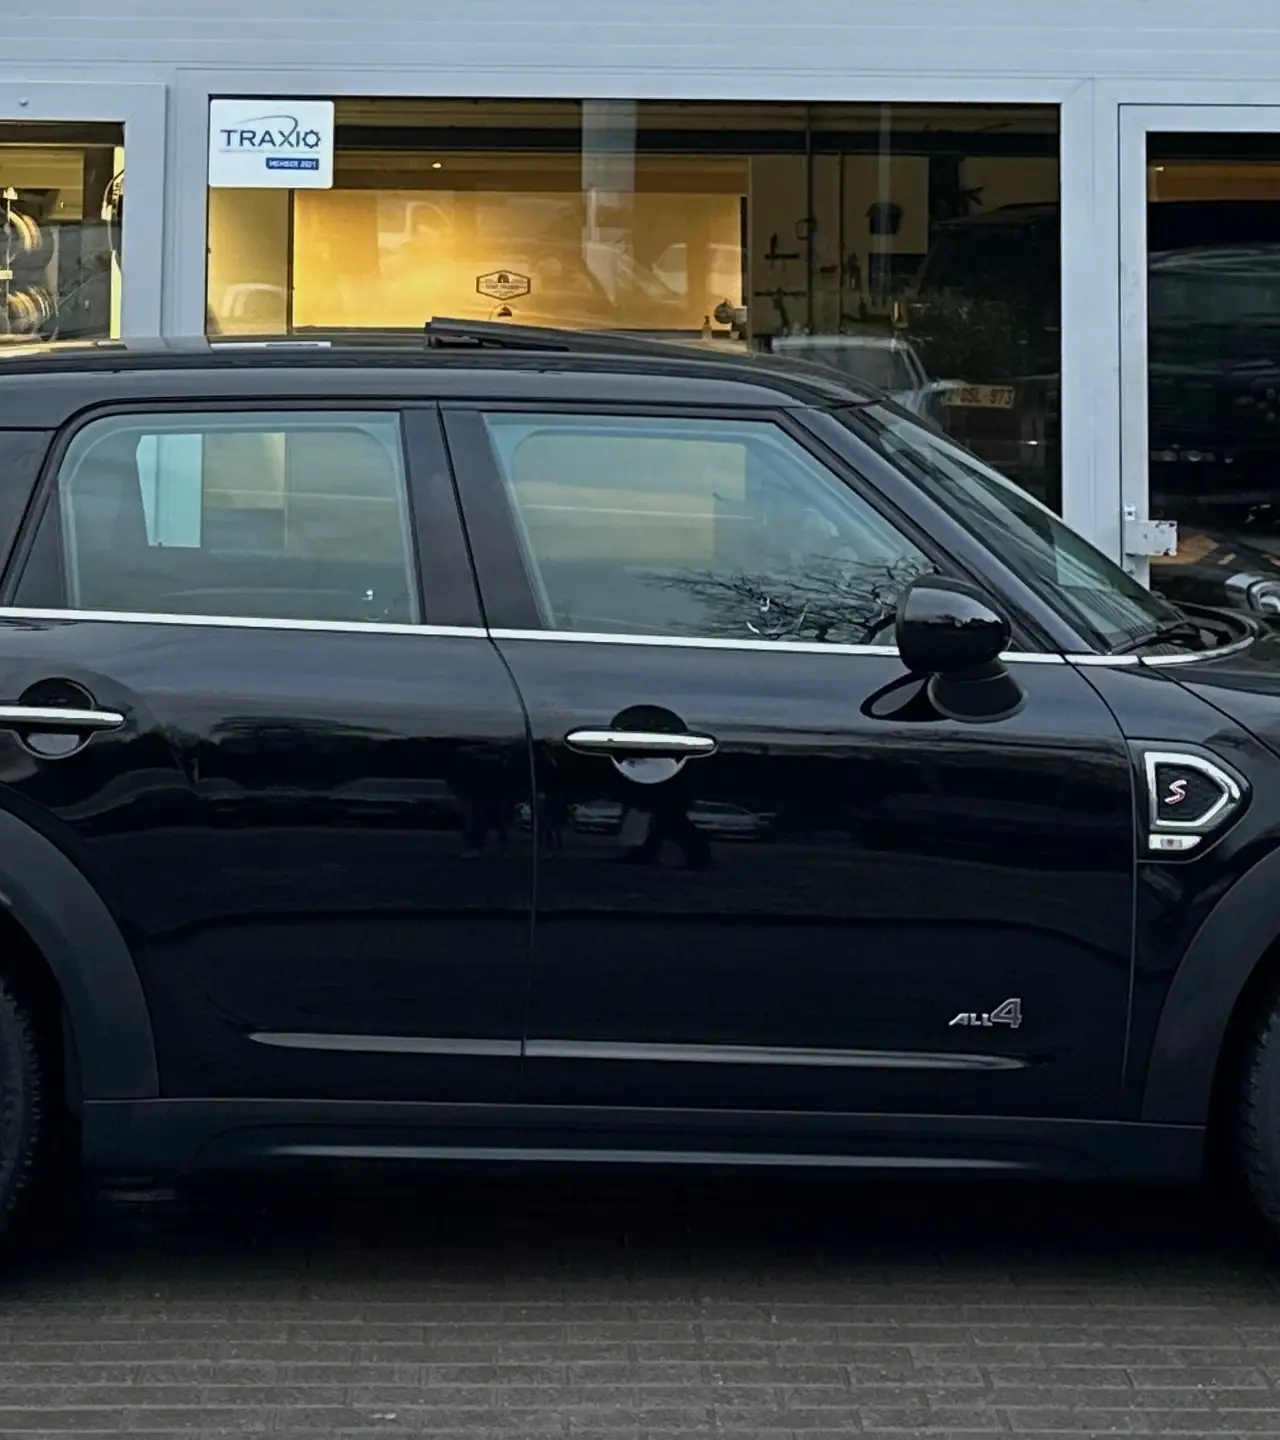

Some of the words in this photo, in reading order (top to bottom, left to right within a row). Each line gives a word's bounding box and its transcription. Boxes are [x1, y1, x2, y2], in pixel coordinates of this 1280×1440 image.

[219, 129, 322, 149] TRAXIO
[1163, 779, 1188, 805] S
[948, 997, 1022, 1029] ALL4
